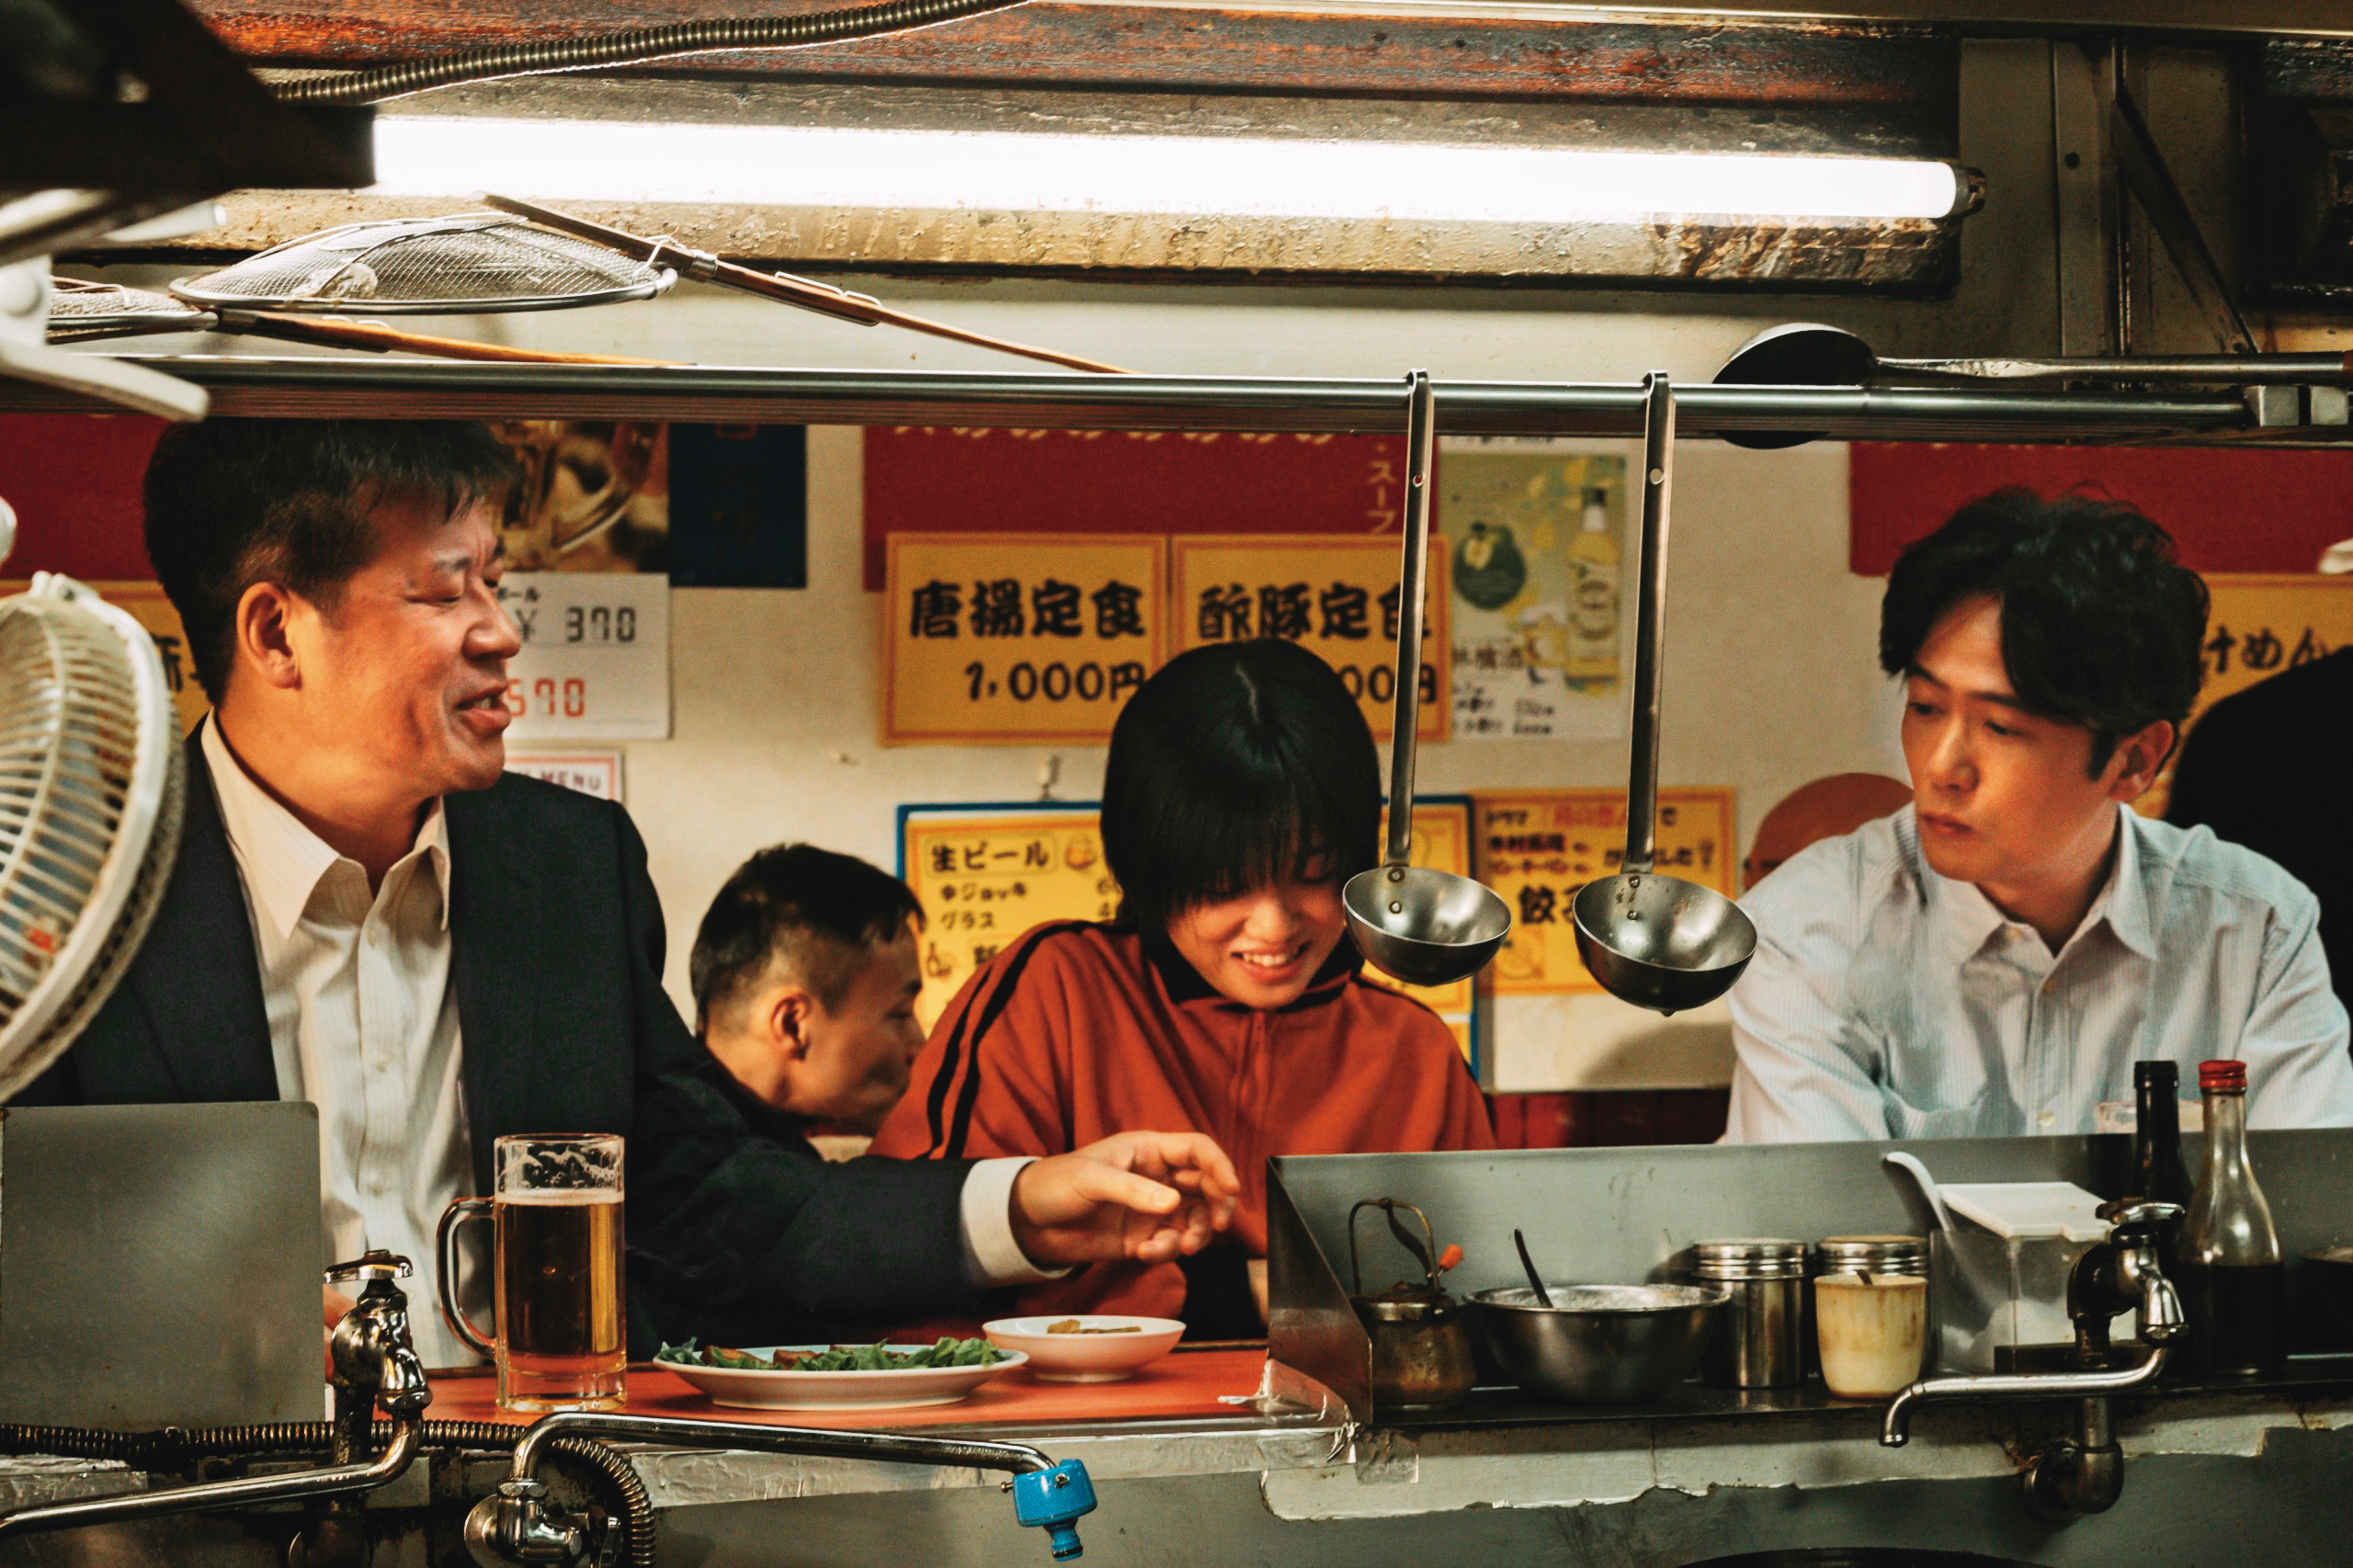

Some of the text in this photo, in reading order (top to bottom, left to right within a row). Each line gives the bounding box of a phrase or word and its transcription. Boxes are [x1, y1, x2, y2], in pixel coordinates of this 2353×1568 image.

[566, 606, 637, 642] 370
[910, 578, 1146, 639] 唐揚定食
[965, 660, 1145, 702] 1,000円
[932, 840, 1049, 872] 生ビール
[941, 911, 995, 929] グラス
